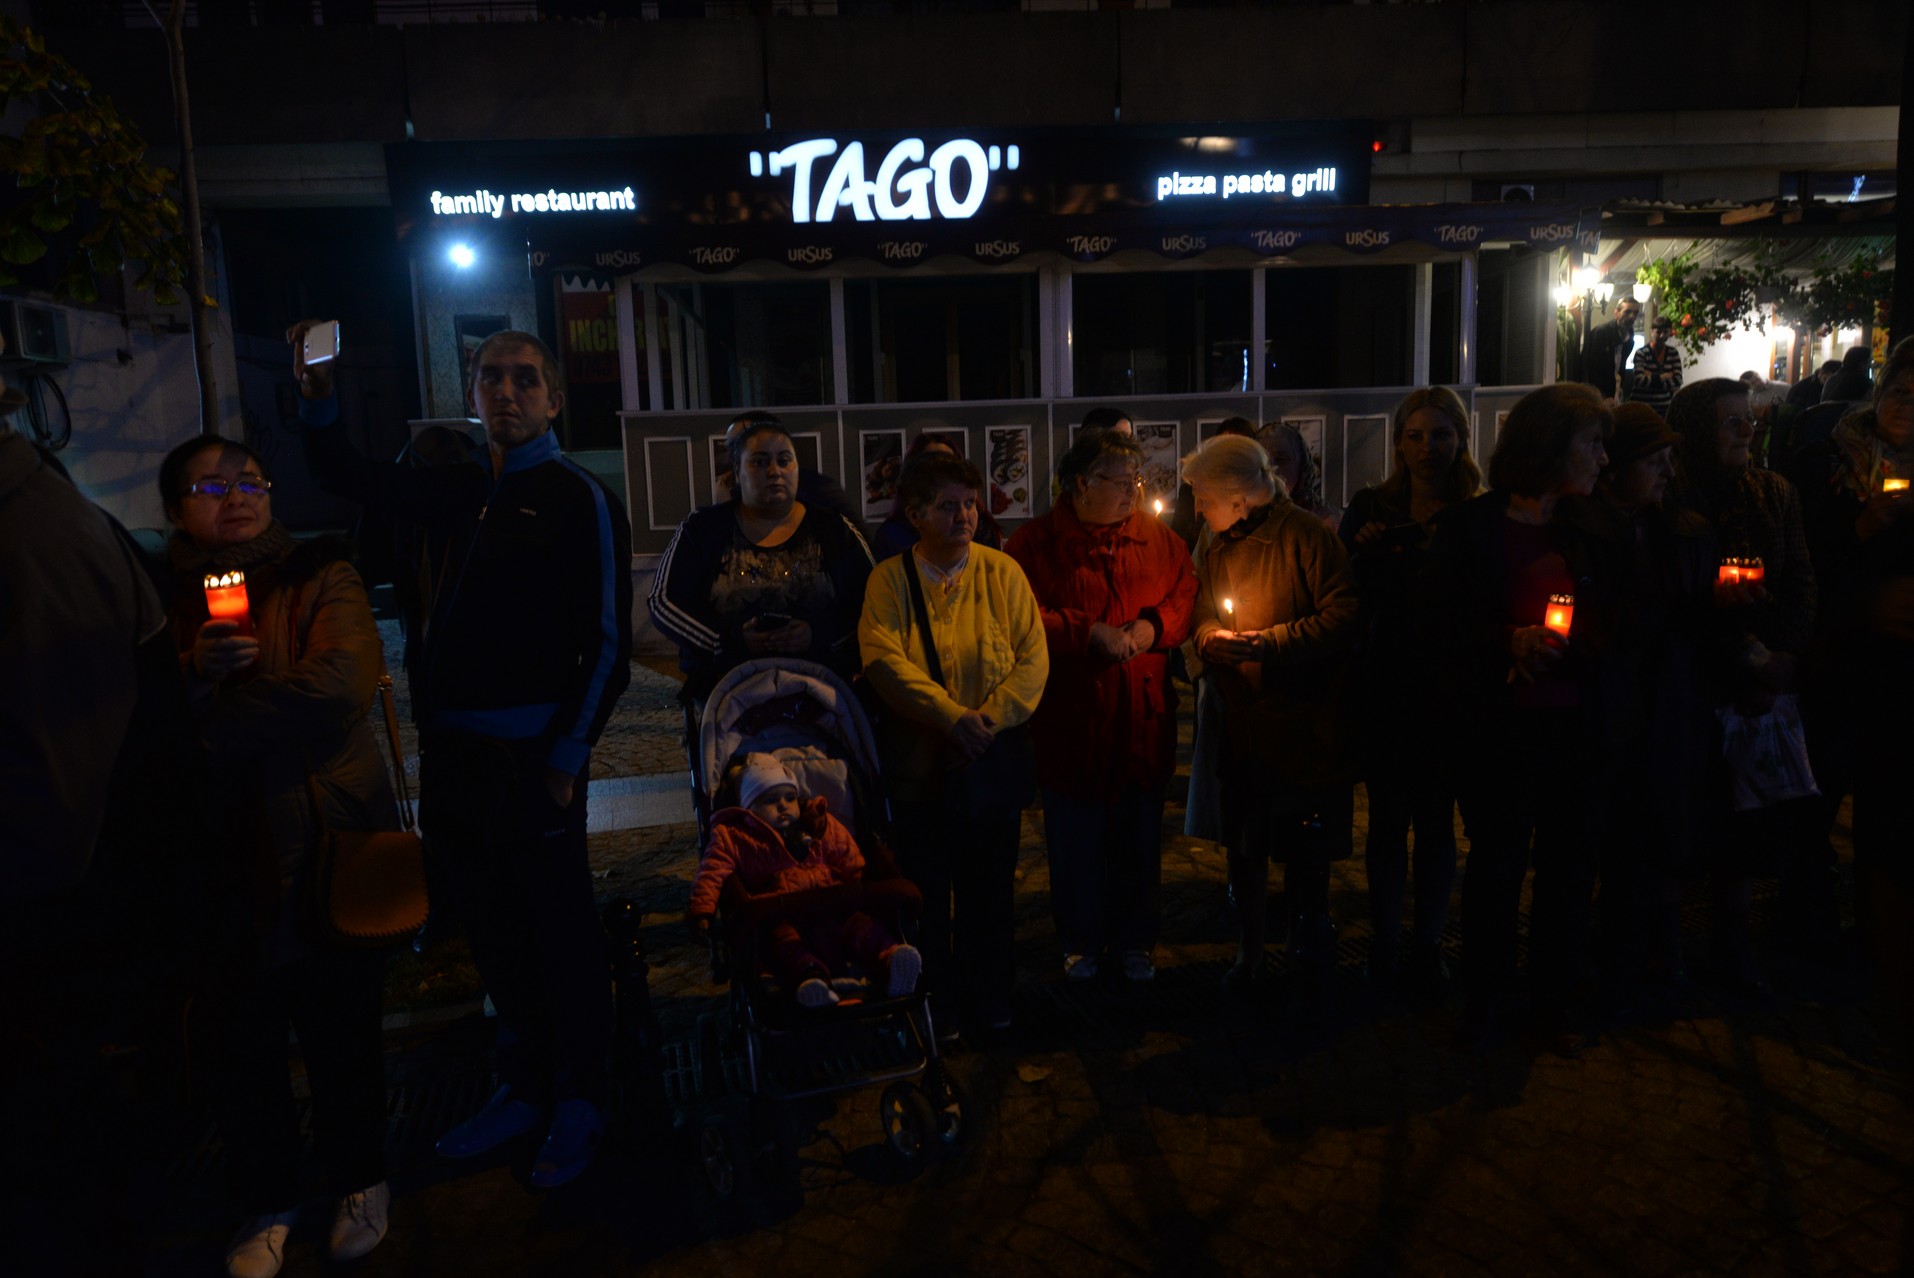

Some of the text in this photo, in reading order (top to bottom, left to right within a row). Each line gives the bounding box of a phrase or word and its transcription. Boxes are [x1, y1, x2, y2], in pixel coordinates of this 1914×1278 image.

[1157, 167, 1337, 200] pizza pasta grill
[430, 186, 636, 218] family restaurant
[1345, 228, 1391, 248] URSUS
[1530, 223, 1576, 241] URSUS
[975, 239, 1021, 258] URSUS
[1162, 234, 1207, 252] URSUS
[595, 250, 641, 268] URSUS
[787, 245, 833, 264] URSUS
